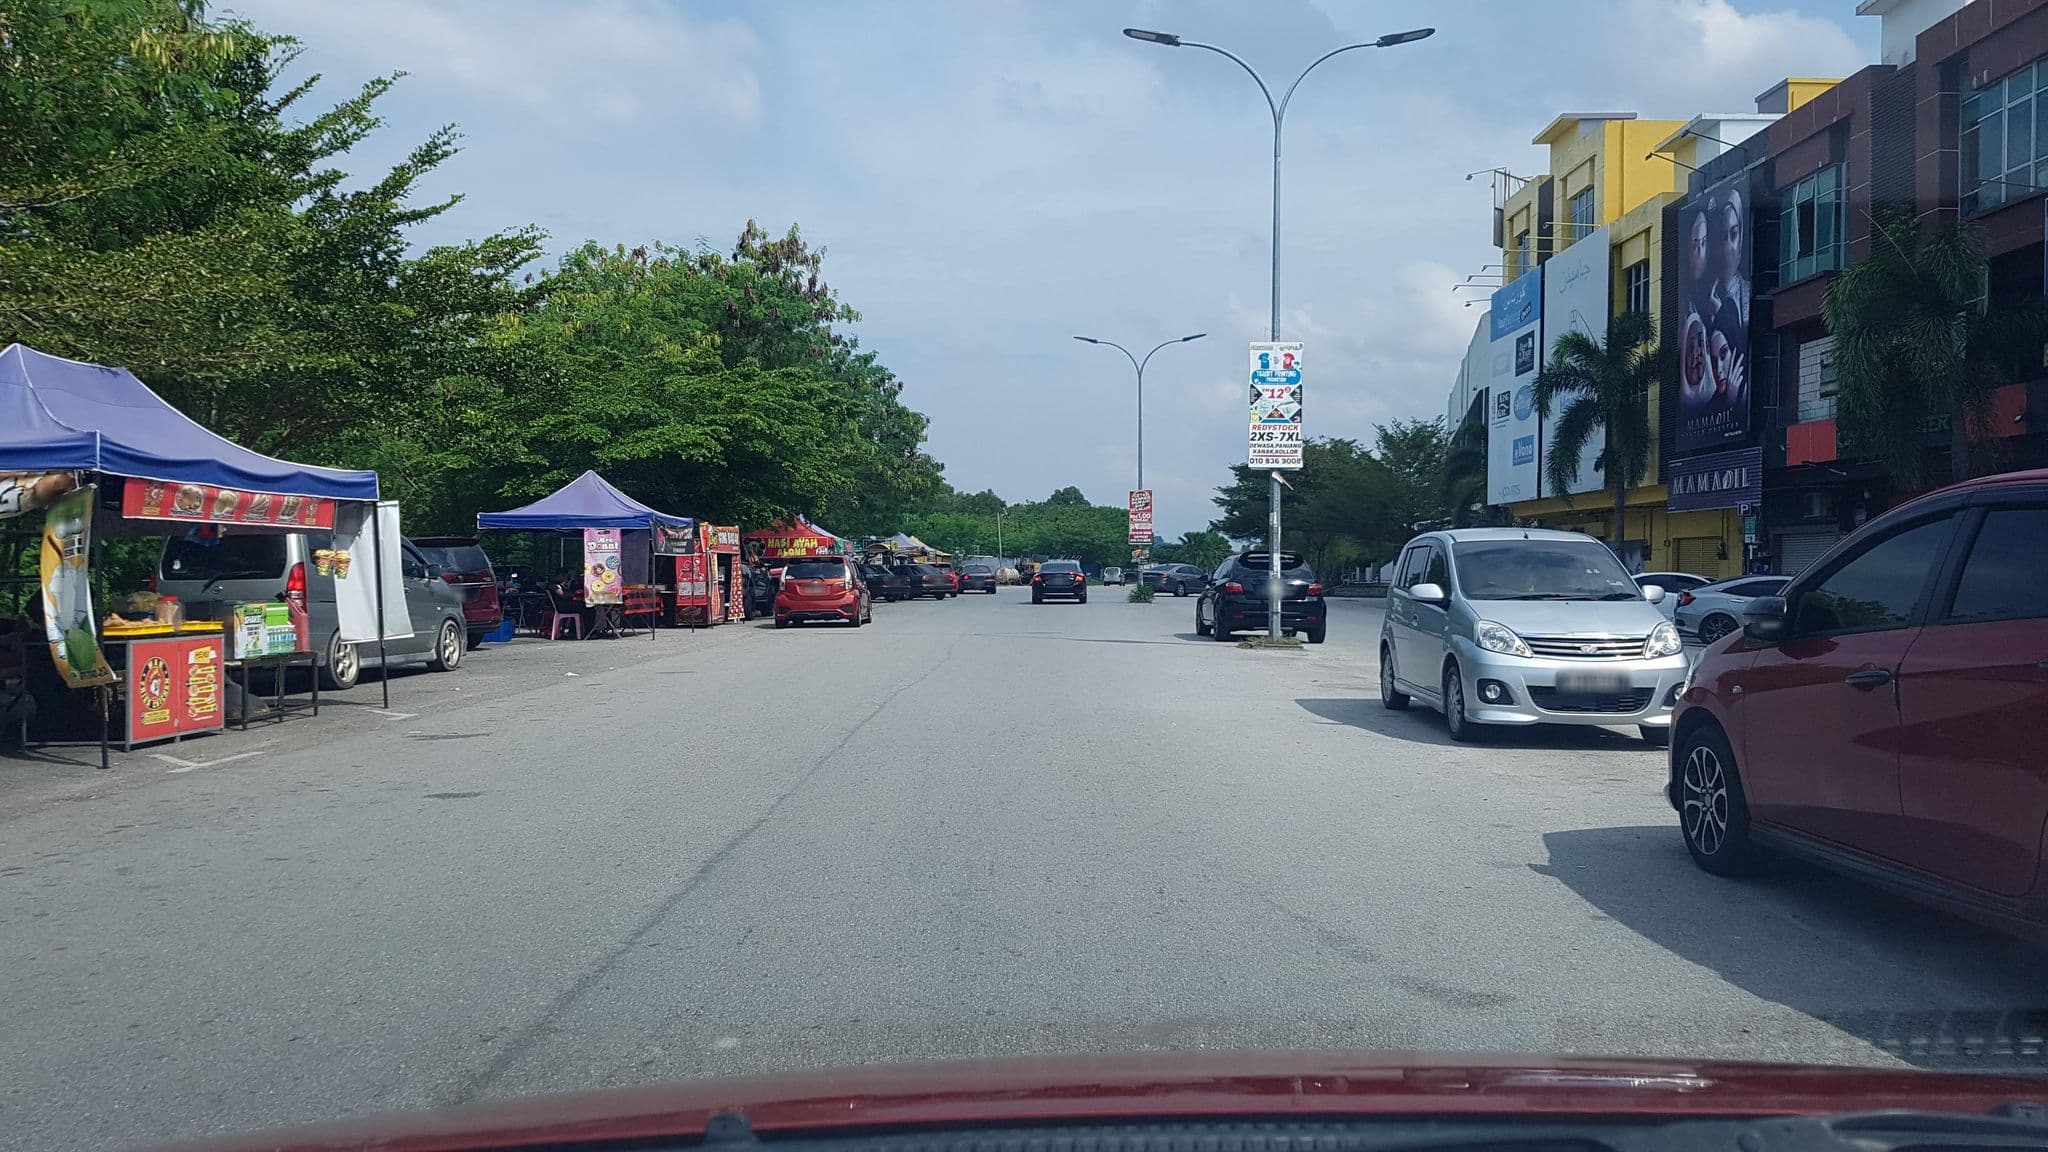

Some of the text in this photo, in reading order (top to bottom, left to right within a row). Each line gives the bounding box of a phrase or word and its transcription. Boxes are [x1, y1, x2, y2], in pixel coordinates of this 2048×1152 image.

[1268, 388, 1284, 399] 12
[1250, 432, 1303, 442] 2XS-7XL
[1740, 504, 1750, 514] P
[768, 537, 790, 548] NASI
[777, 548, 807, 557] ALONG
